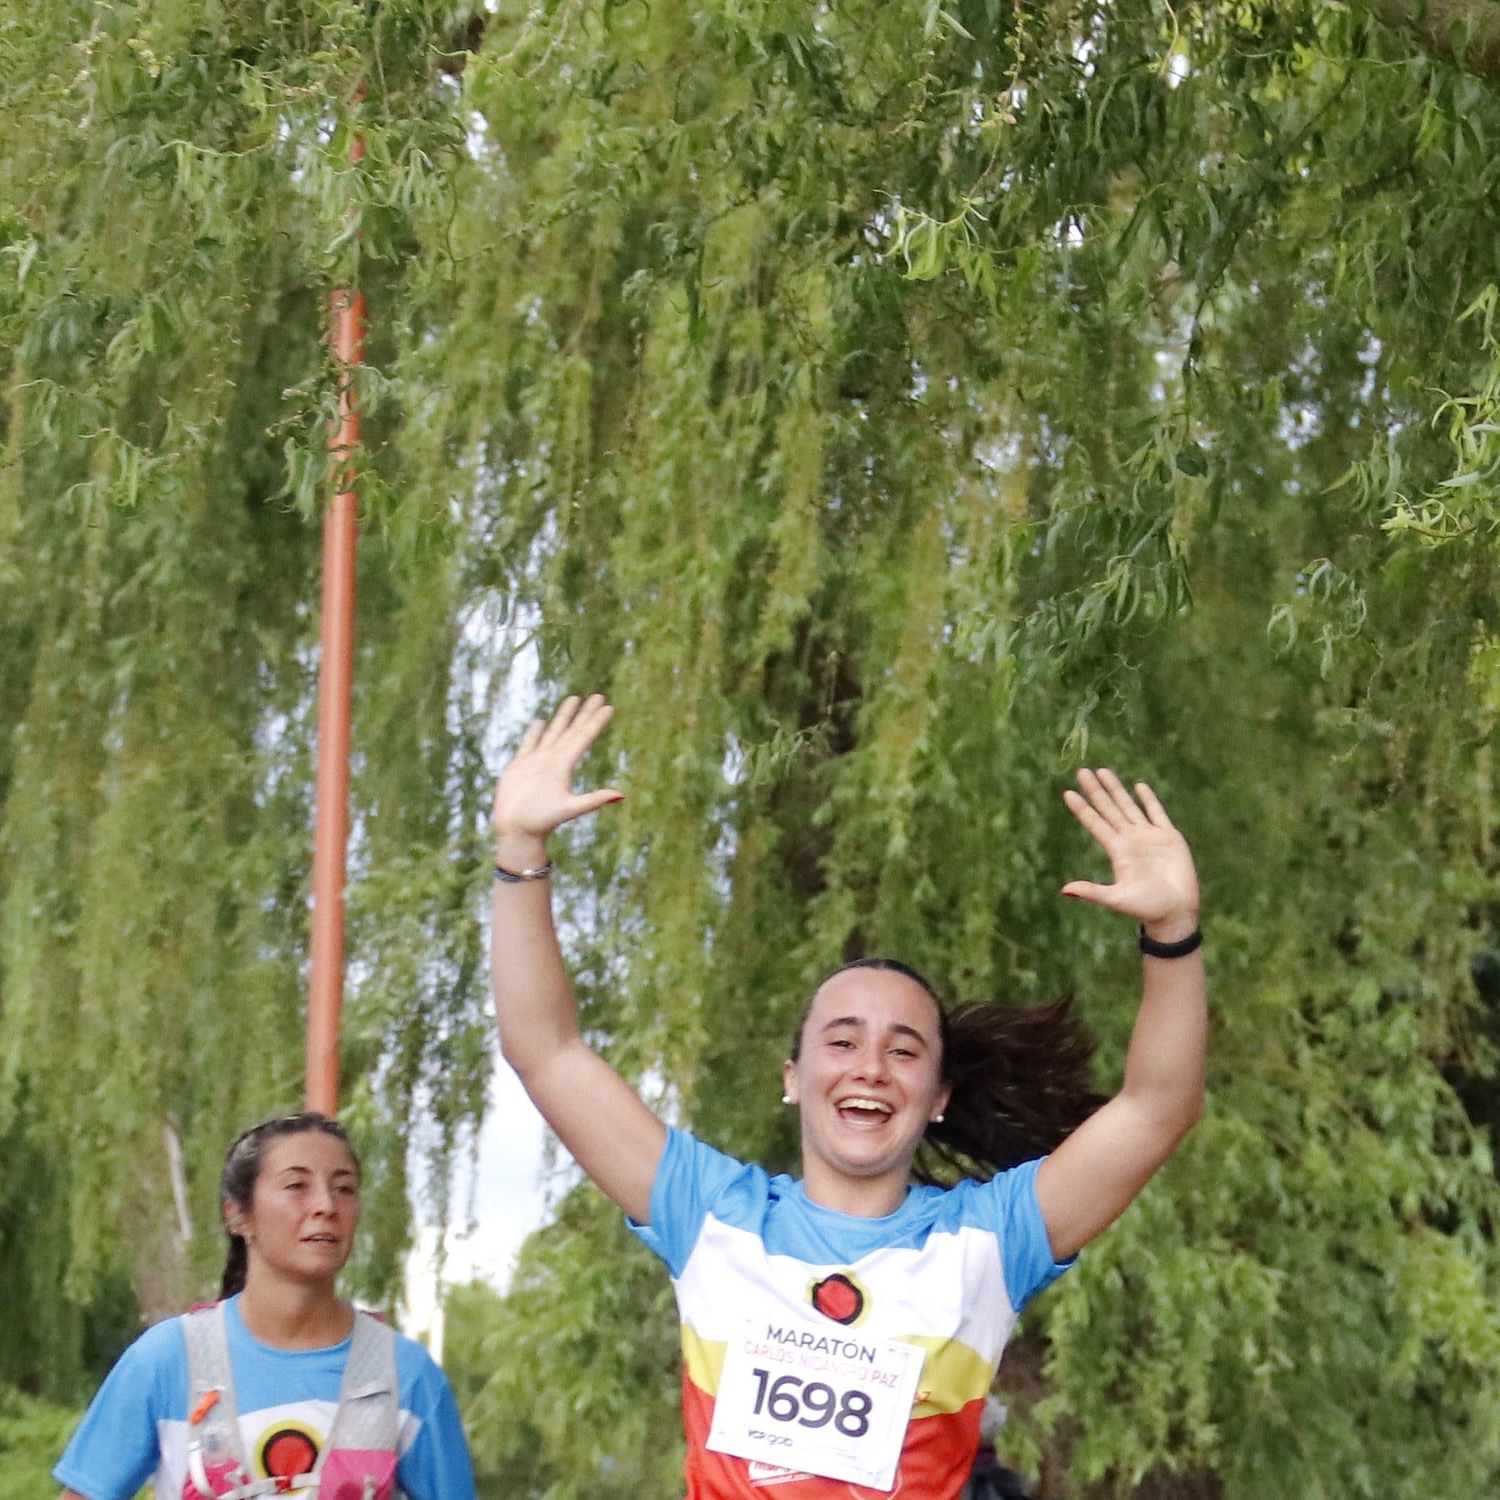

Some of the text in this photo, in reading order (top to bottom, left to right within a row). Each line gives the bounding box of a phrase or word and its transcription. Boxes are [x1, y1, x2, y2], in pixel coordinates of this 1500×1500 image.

[766, 1324, 877, 1364] MARATÓN
[871, 1370, 900, 1389] PAZ
[752, 1368, 873, 1438] 1698
